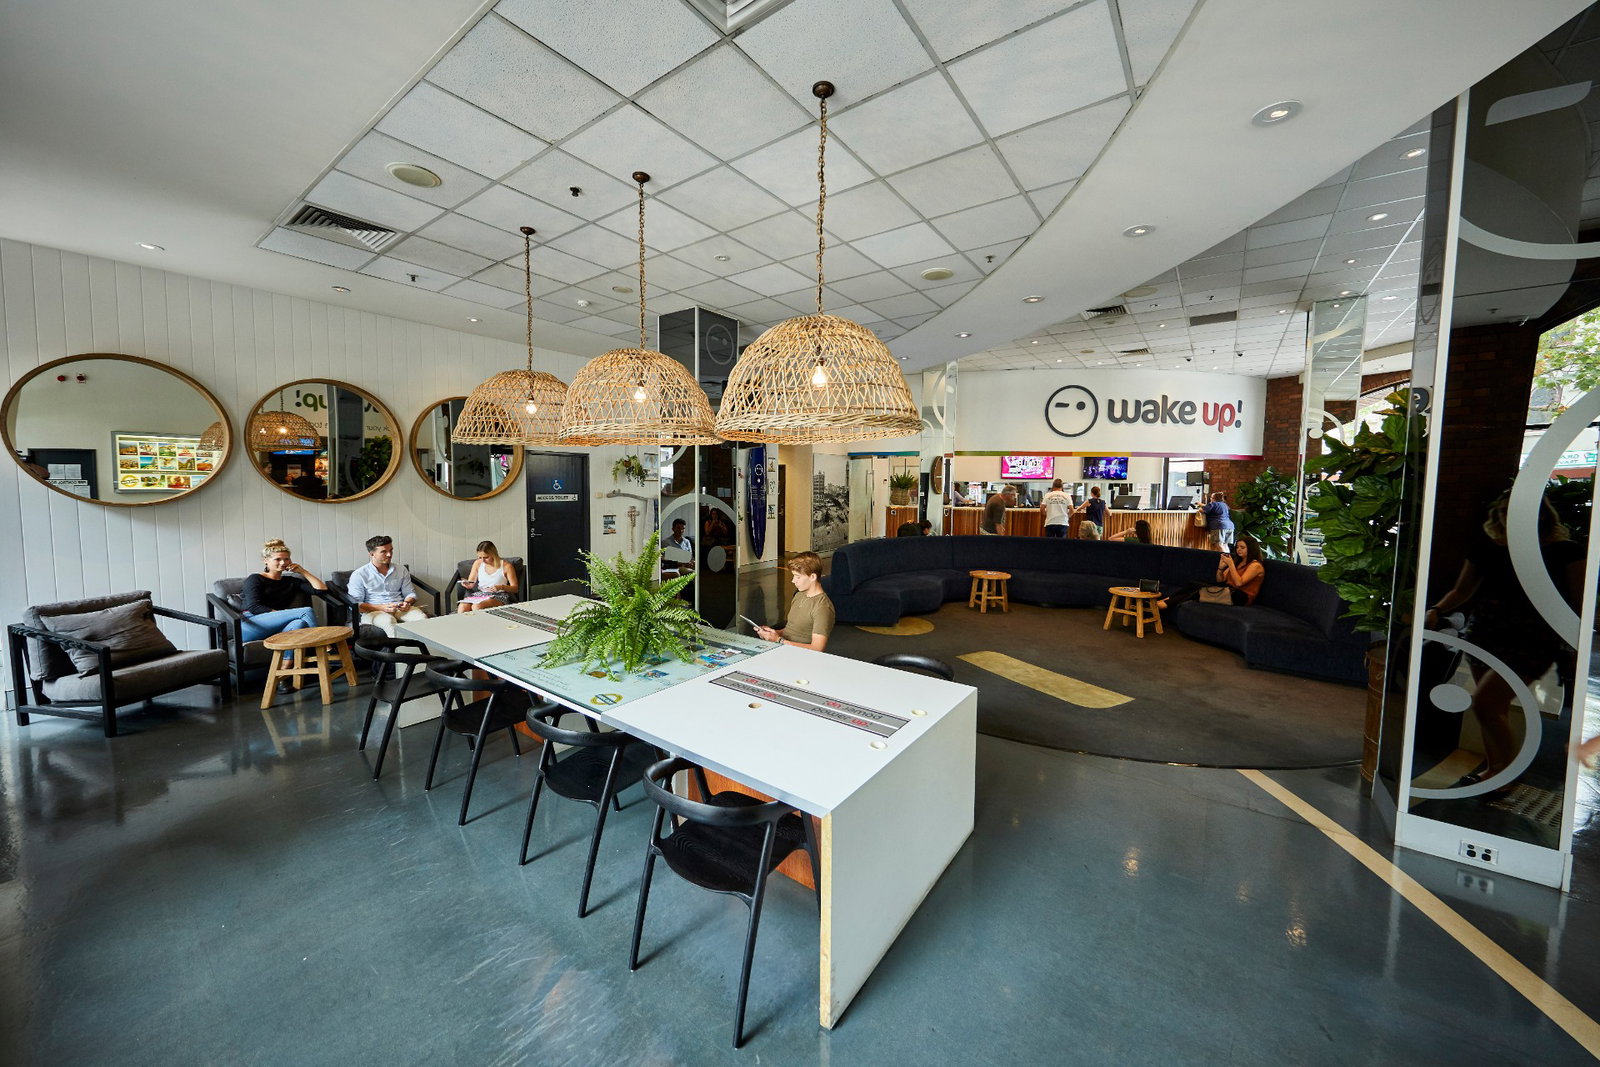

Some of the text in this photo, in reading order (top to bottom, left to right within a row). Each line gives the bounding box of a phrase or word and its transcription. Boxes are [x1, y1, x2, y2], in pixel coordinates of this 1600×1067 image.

[1107, 394, 1243, 433] wake up!
[811, 707, 850, 720] power
